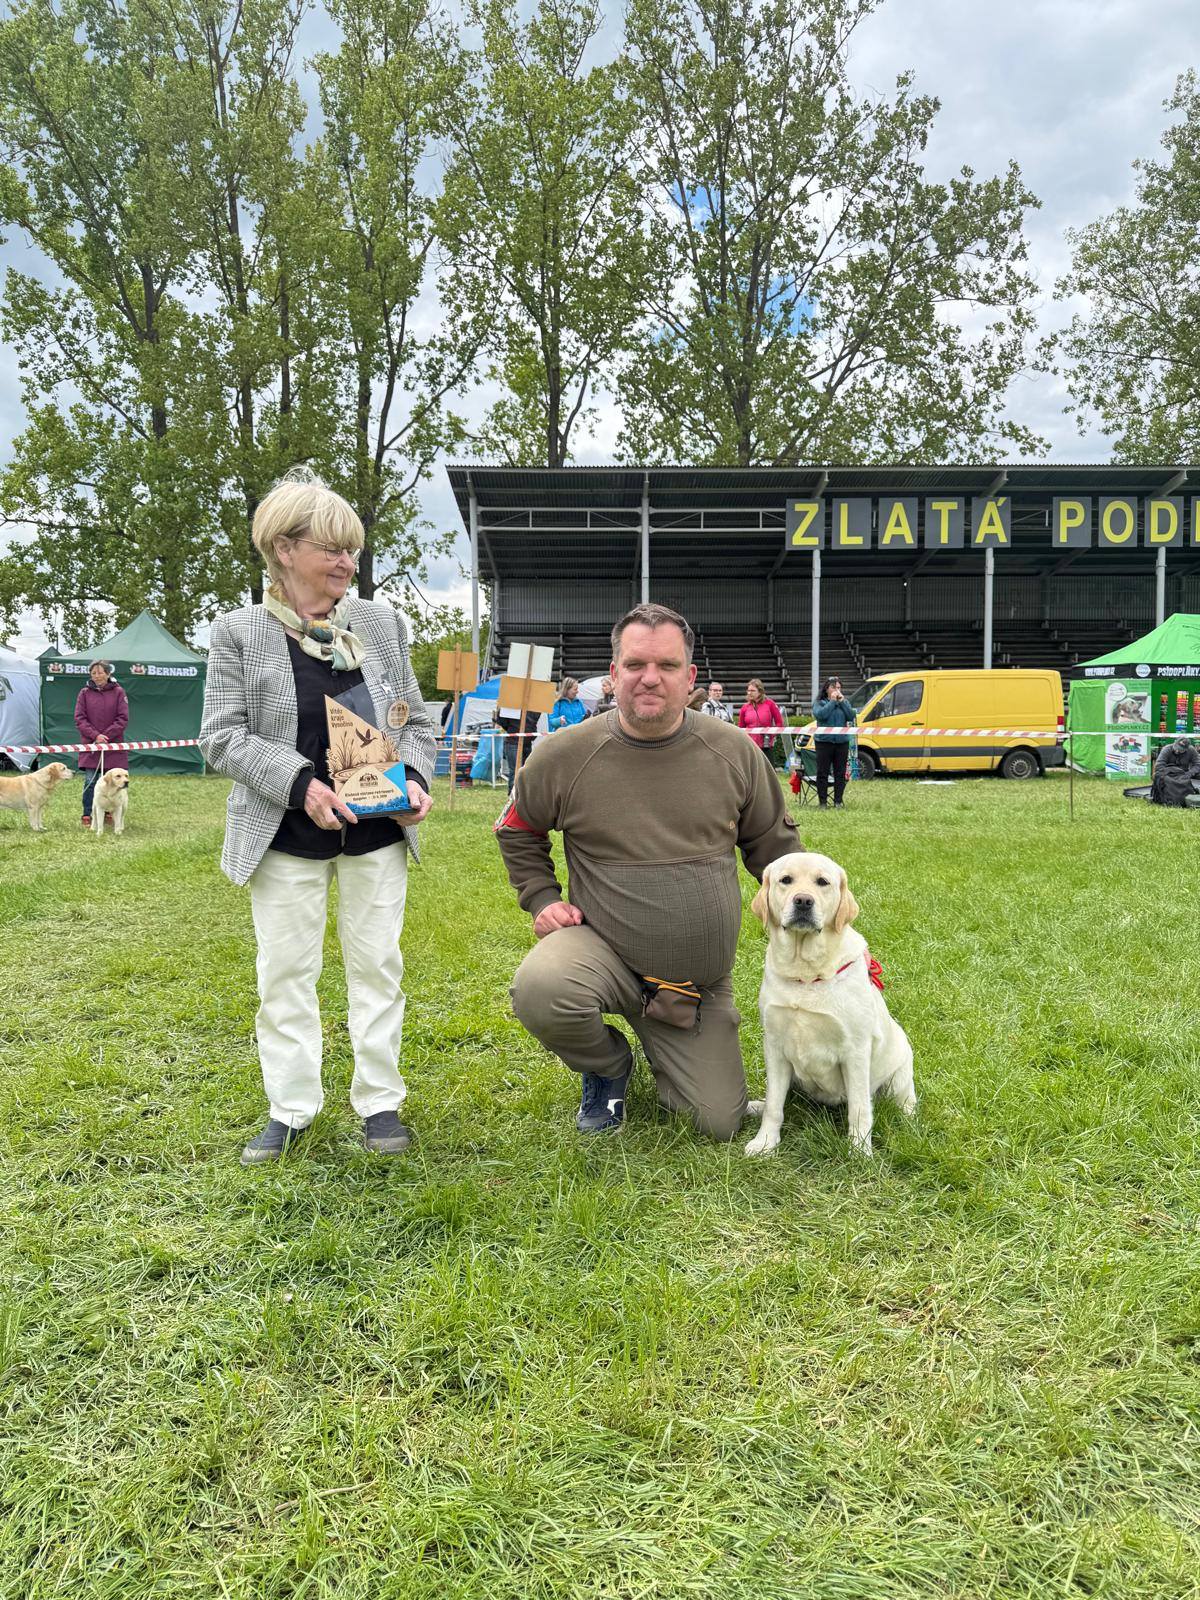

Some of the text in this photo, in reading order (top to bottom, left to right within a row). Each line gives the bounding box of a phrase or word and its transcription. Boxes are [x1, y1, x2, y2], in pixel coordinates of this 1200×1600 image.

[791, 497, 1200, 545] ZLATÁ POD
[147, 665, 198, 677] BERNARD
